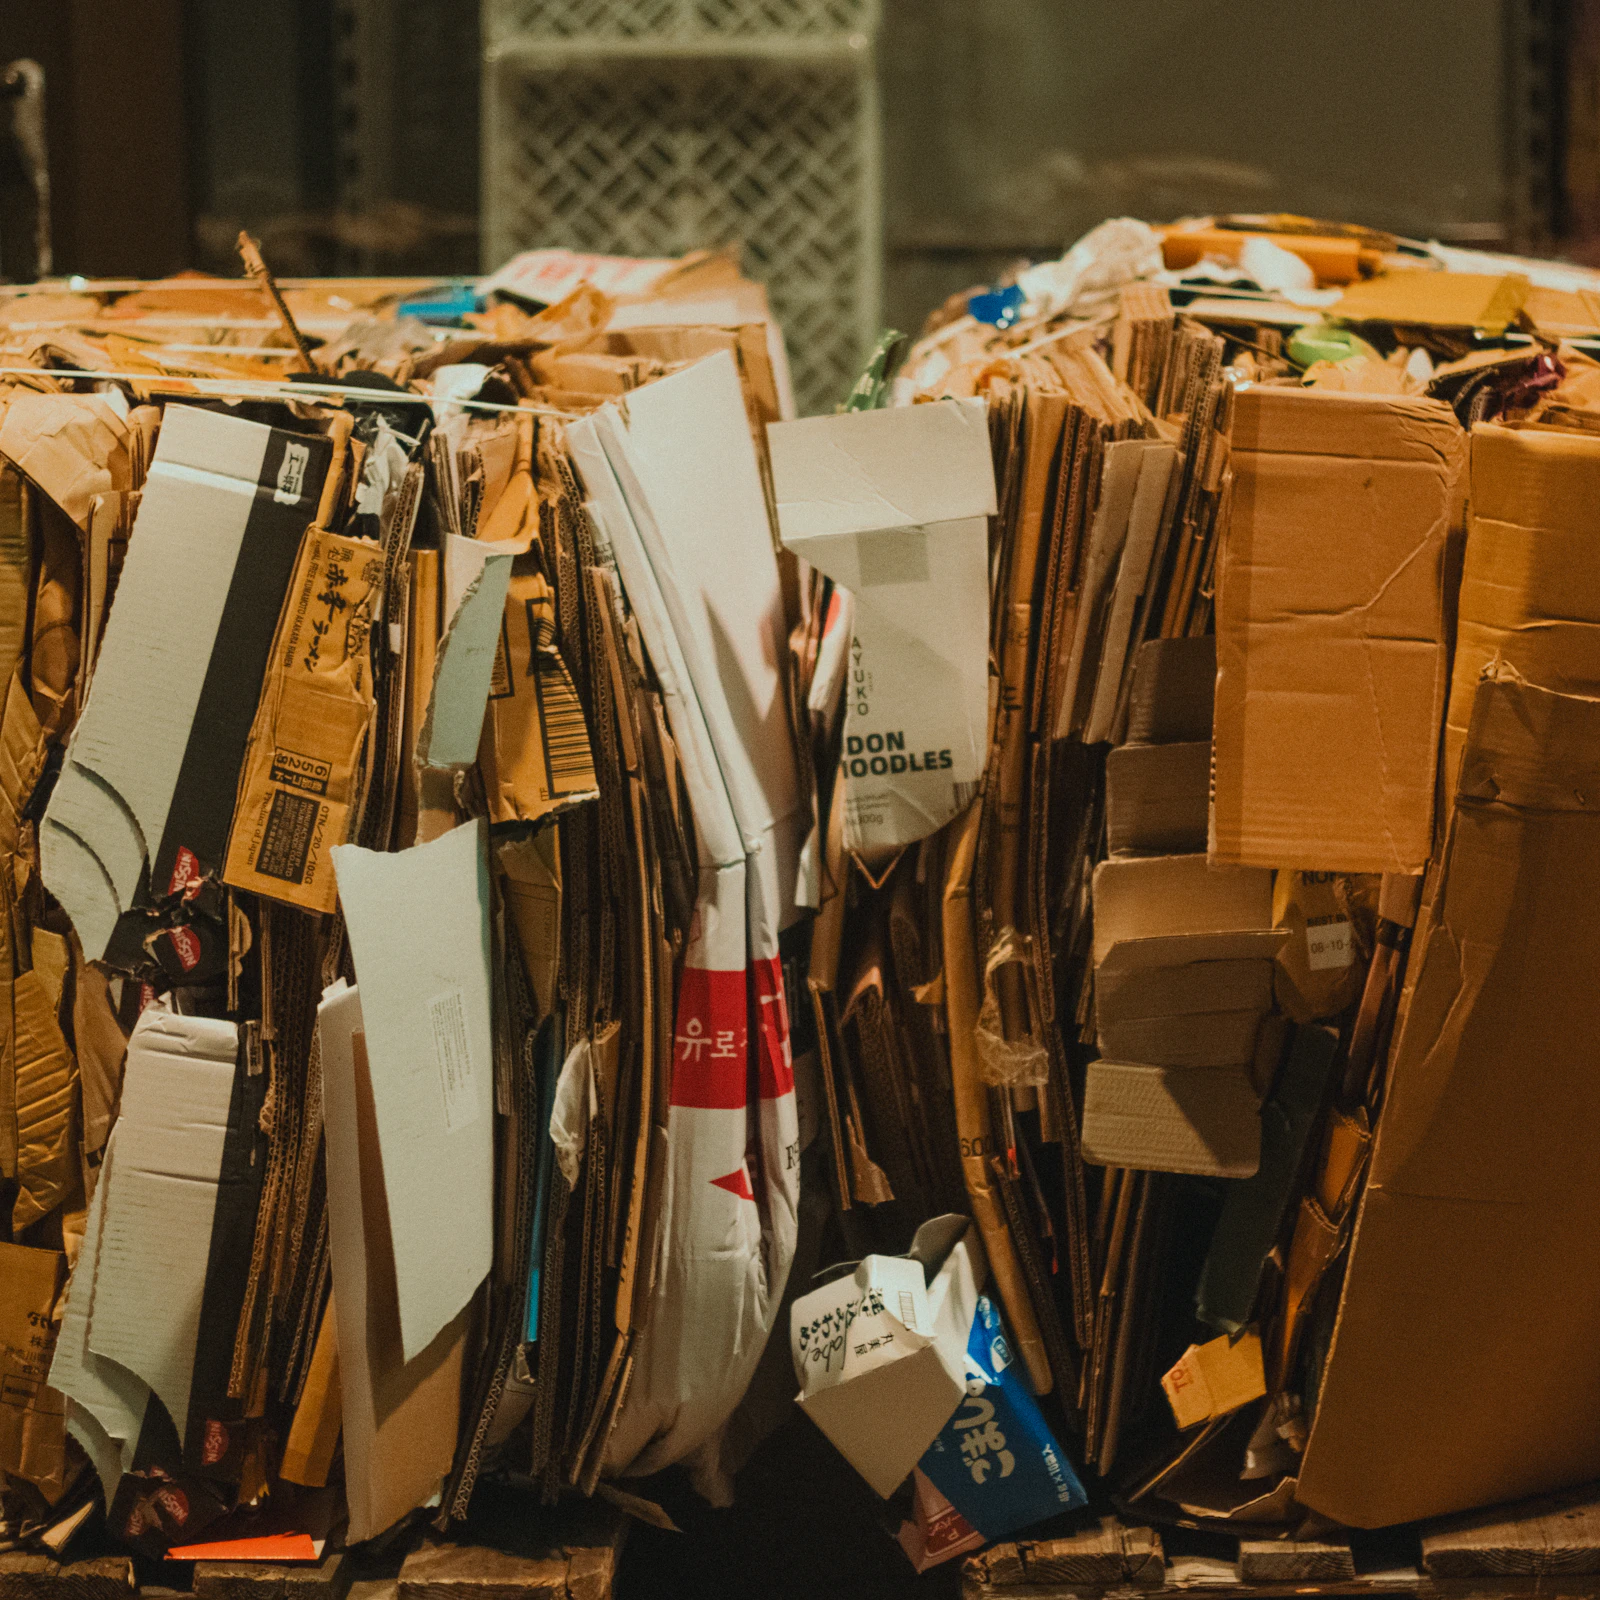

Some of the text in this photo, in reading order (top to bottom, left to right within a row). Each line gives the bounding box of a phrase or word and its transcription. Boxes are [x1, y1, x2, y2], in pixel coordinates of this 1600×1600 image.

[307, 562, 319, 579] FREE
[298, 579, 314, 615] KUMAMOTO
[290, 614, 303, 645] AKAKARA
[284, 646, 296, 668] RAMEN
[852, 636, 869, 716] AYUKO
[847, 731, 905, 755] DON
[247, 792, 272, 866] Product of Japan
